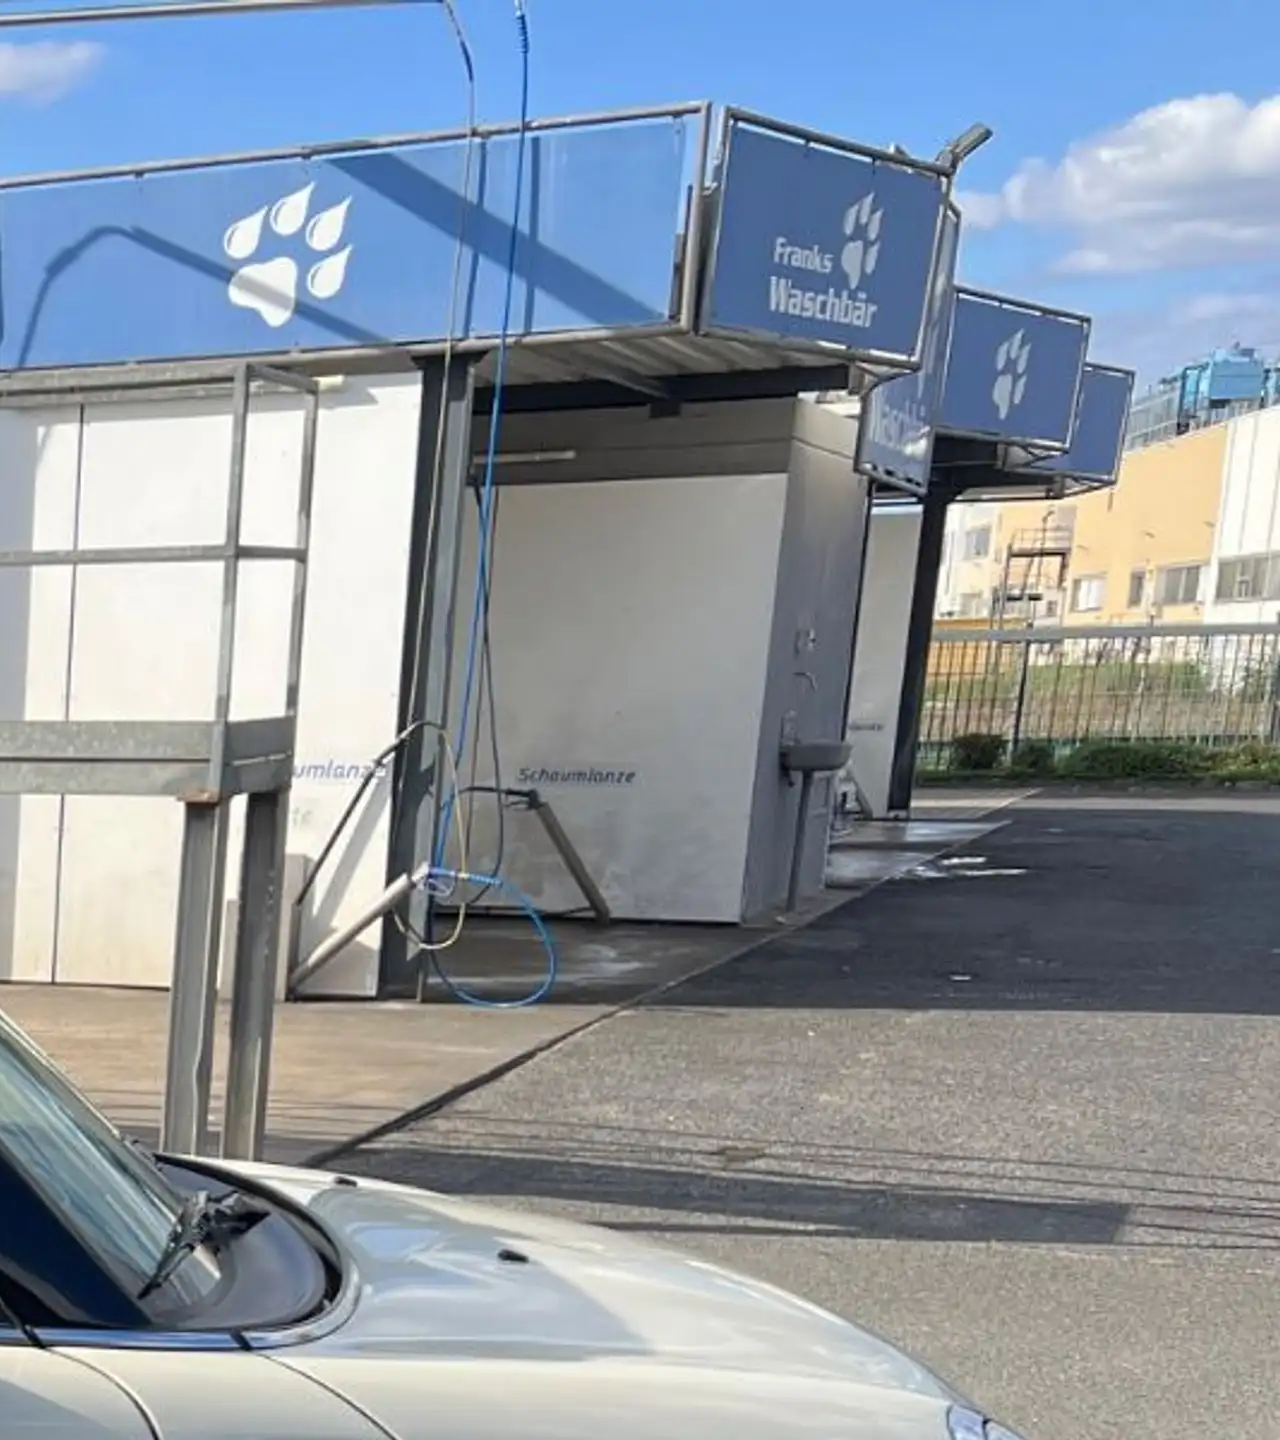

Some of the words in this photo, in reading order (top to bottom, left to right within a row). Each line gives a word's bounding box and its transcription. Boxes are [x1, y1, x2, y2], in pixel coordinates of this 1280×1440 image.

[773, 236, 835, 274] Franks
[769, 275, 878, 328] Waschbär
[517, 766, 637, 785] Schaumlanze
